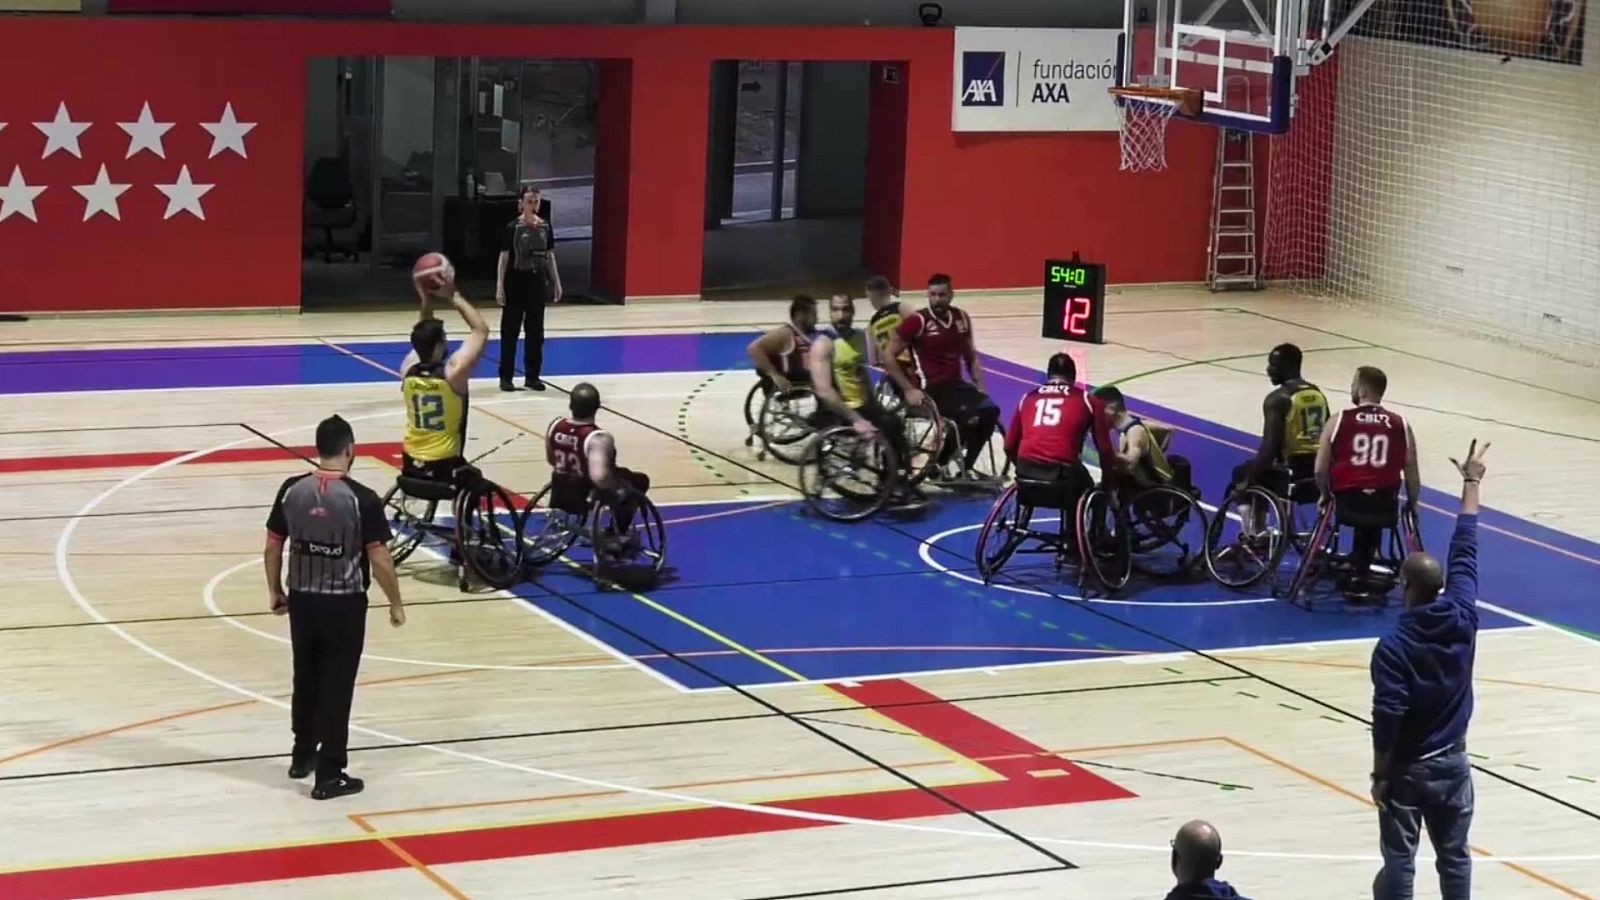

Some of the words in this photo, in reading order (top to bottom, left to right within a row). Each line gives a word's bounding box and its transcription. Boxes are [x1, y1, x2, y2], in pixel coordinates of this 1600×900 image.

[962, 79, 997, 102] AXA
[1031, 83, 1070, 103] AXA
[1063, 297, 1091, 334] 12
[411, 393, 446, 431] 12
[1032, 398, 1065, 427] 15
[1350, 433, 1390, 468] 90
